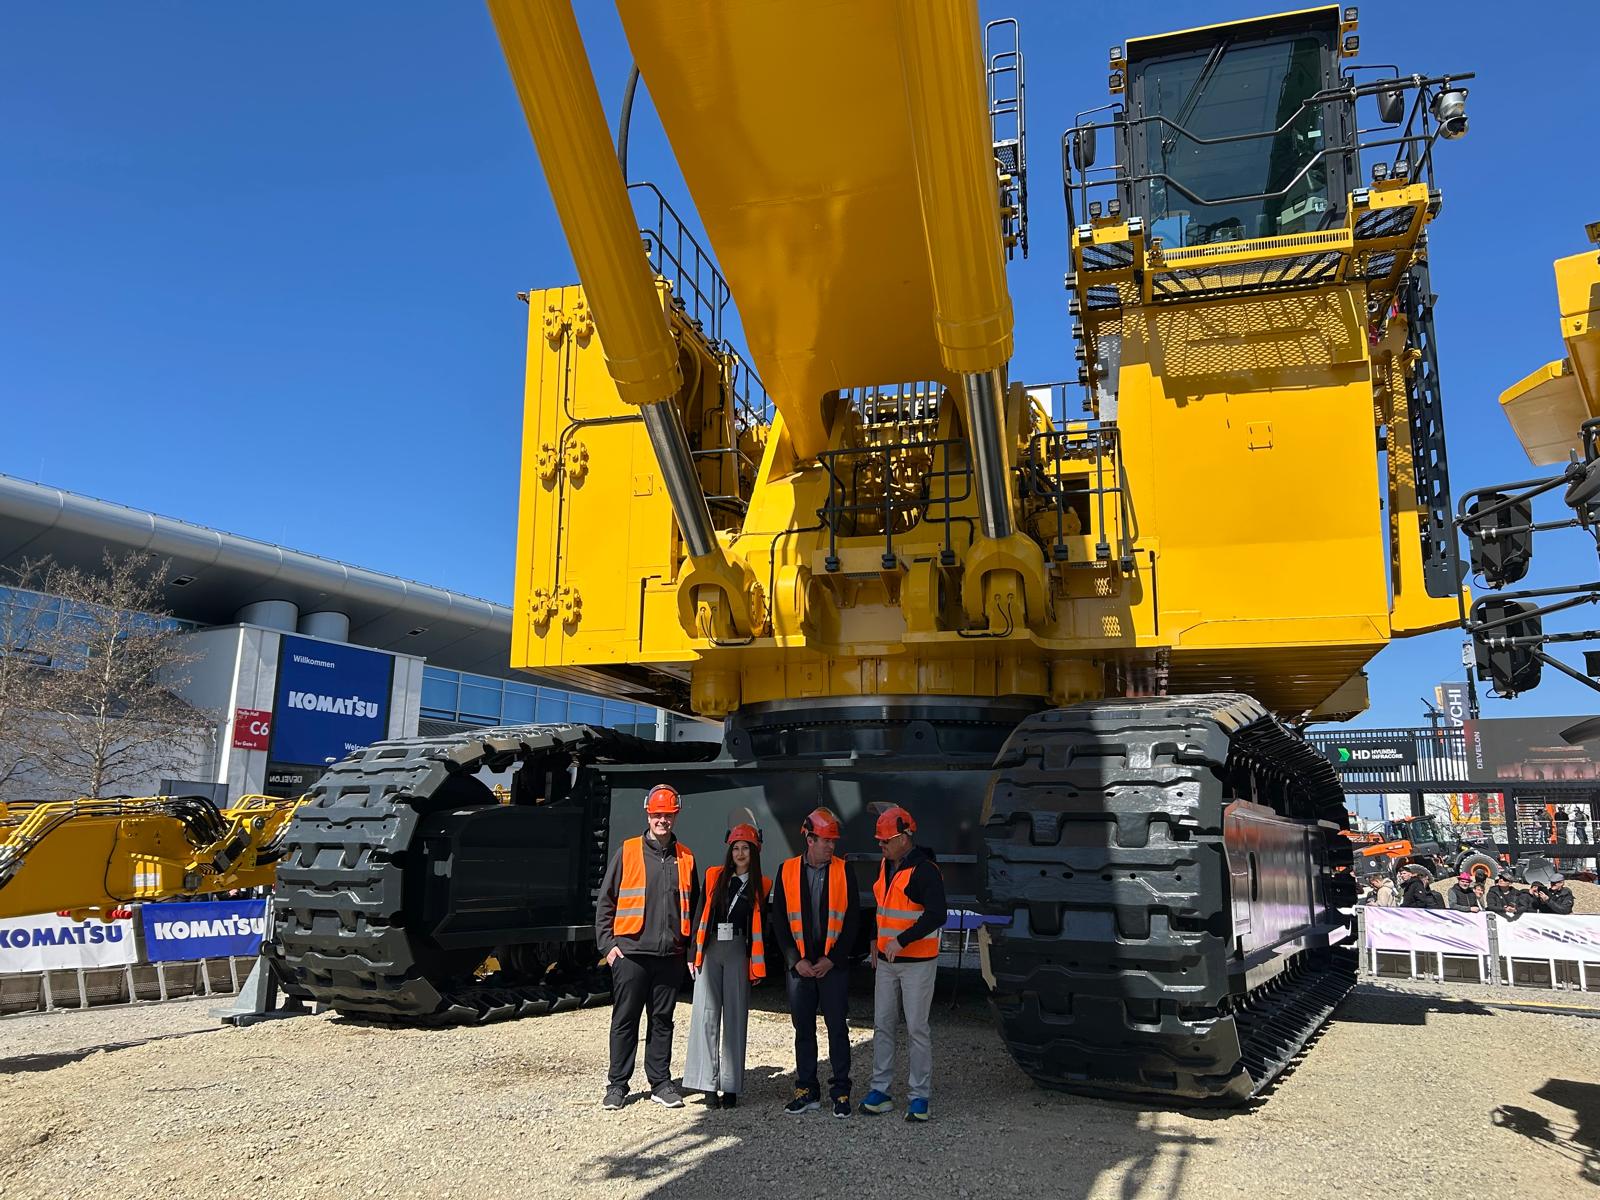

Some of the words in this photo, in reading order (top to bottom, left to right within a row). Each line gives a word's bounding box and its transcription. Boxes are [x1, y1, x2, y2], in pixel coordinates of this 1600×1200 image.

[293, 654, 335, 668] Willkommen
[288, 691, 378, 718] KOMATSU
[250, 721, 269, 736] C6
[1352, 750, 1371, 759] HD
[1474, 731, 1483, 769] DEVELON
[154, 914, 264, 940] KOMATSU
